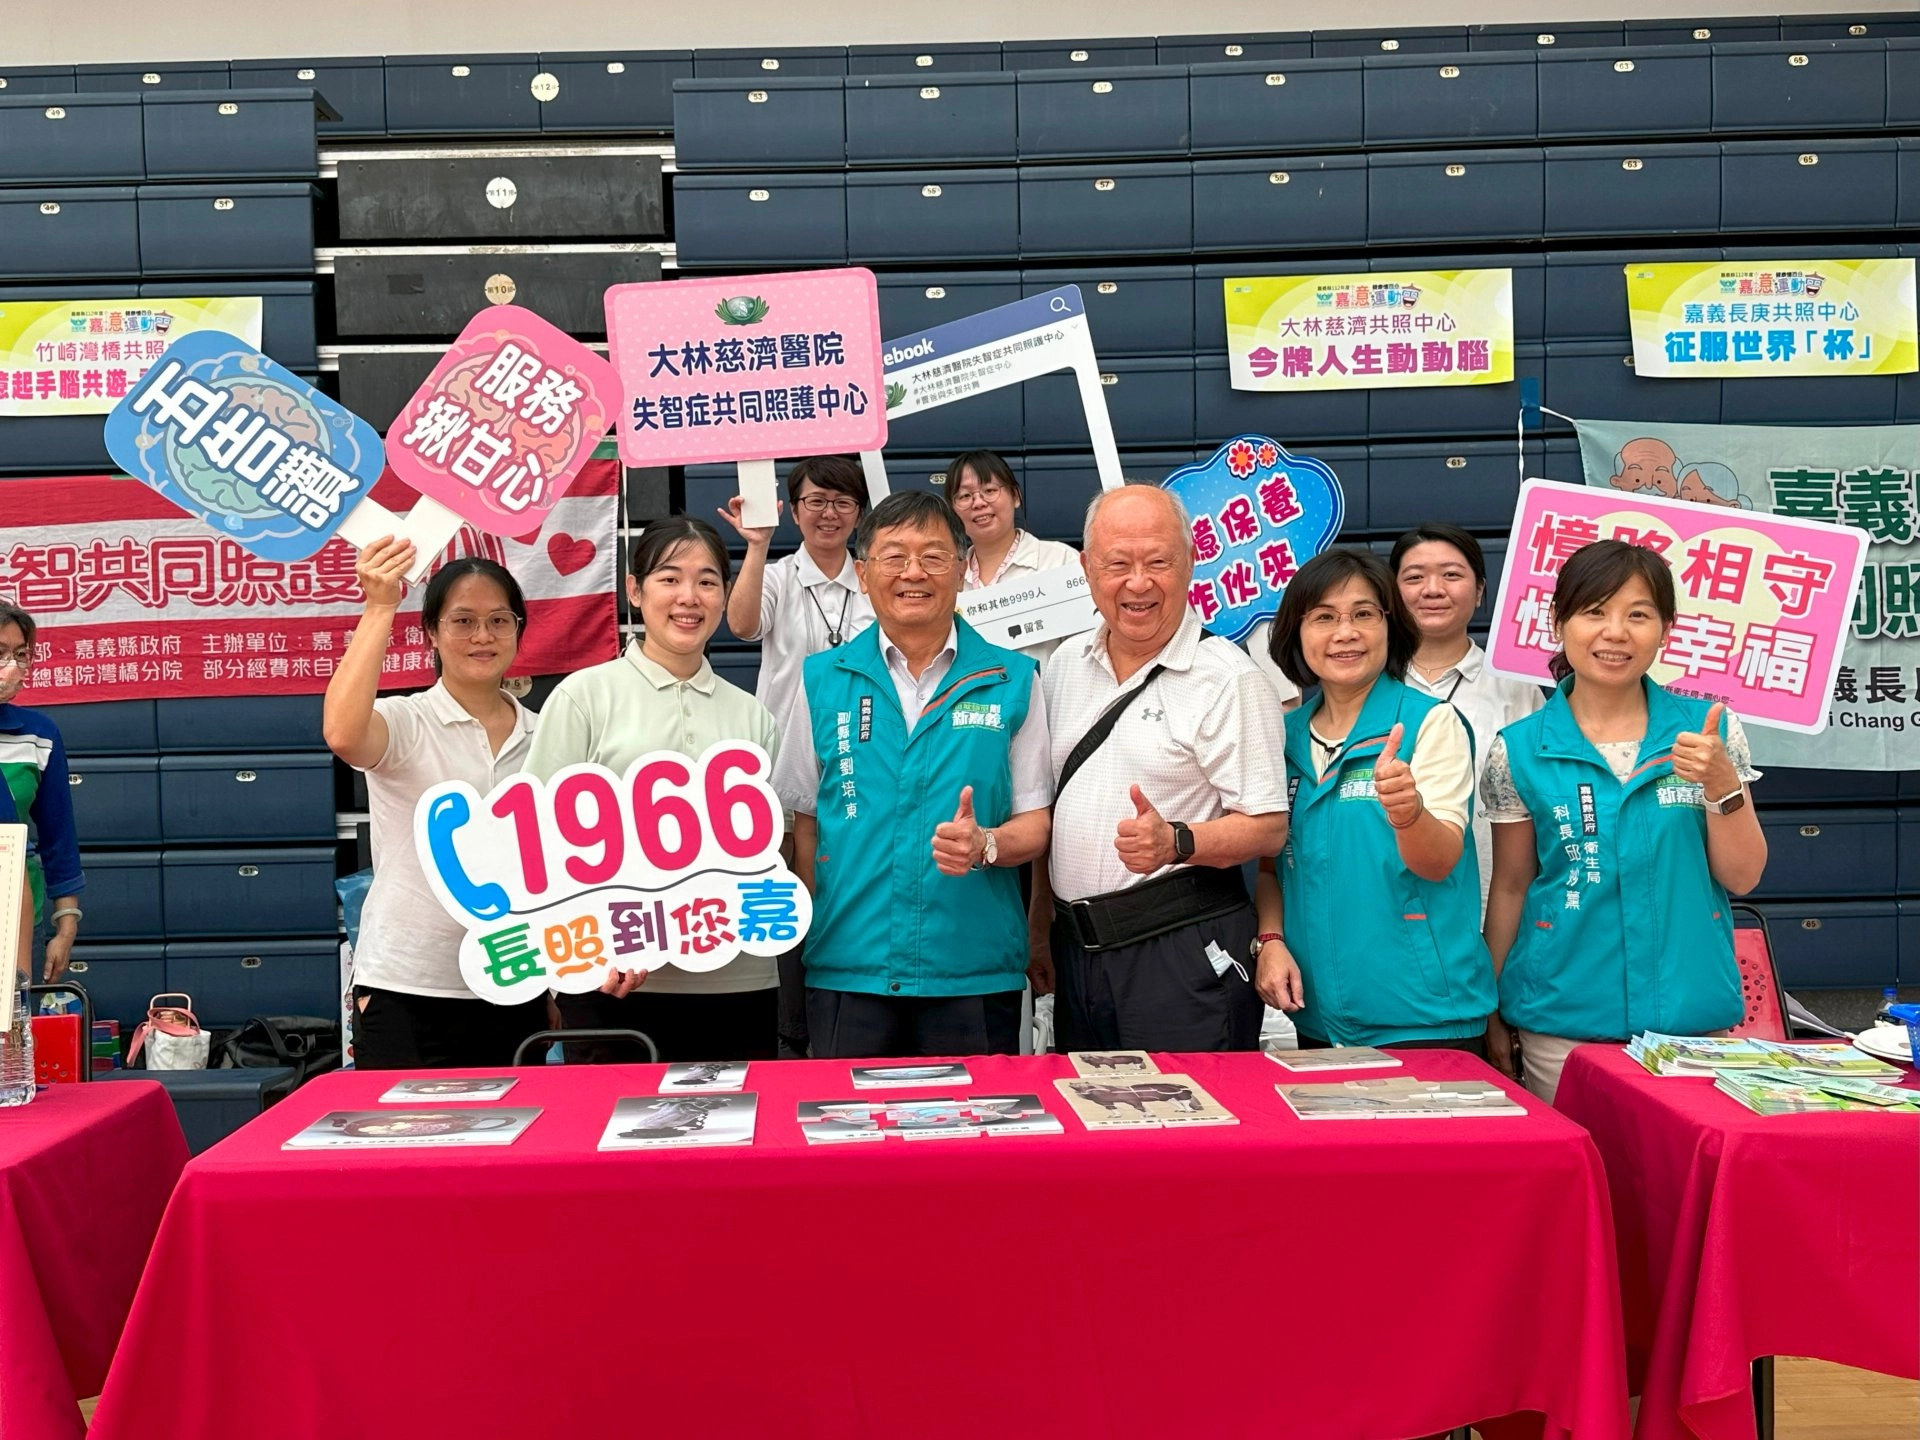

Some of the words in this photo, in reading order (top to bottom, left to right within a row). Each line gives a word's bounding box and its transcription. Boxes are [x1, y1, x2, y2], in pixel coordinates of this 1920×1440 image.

[1281, 312, 1456, 338] 大林慈濟共照中心
[1684, 301, 1860, 324] 嘉義長庚共照中心
[35, 340, 172, 363] 竹崎灣橋共照
[647, 331, 845, 379] 大林慈濟醫院
[912, 330, 1064, 384] 大林慈濟醫院失智症共同照護中心
[1248, 340, 1489, 378] 今牌人生動動腦
[1665, 329, 1871, 363] 征服世界「杯」
[475, 343, 587, 436] 服務
[633, 382, 868, 431] 失智症共同照護中心
[403, 398, 548, 513] 揪甘心
[1769, 468, 1920, 541] 嘉義
[966, 586, 1046, 616] 你和其他9999人
[1023, 619, 1045, 634] 留言
[1840, 711, 1905, 731] Chang
[492, 749, 774, 894] 1966
[478, 878, 799, 988] 長照到您嘉
